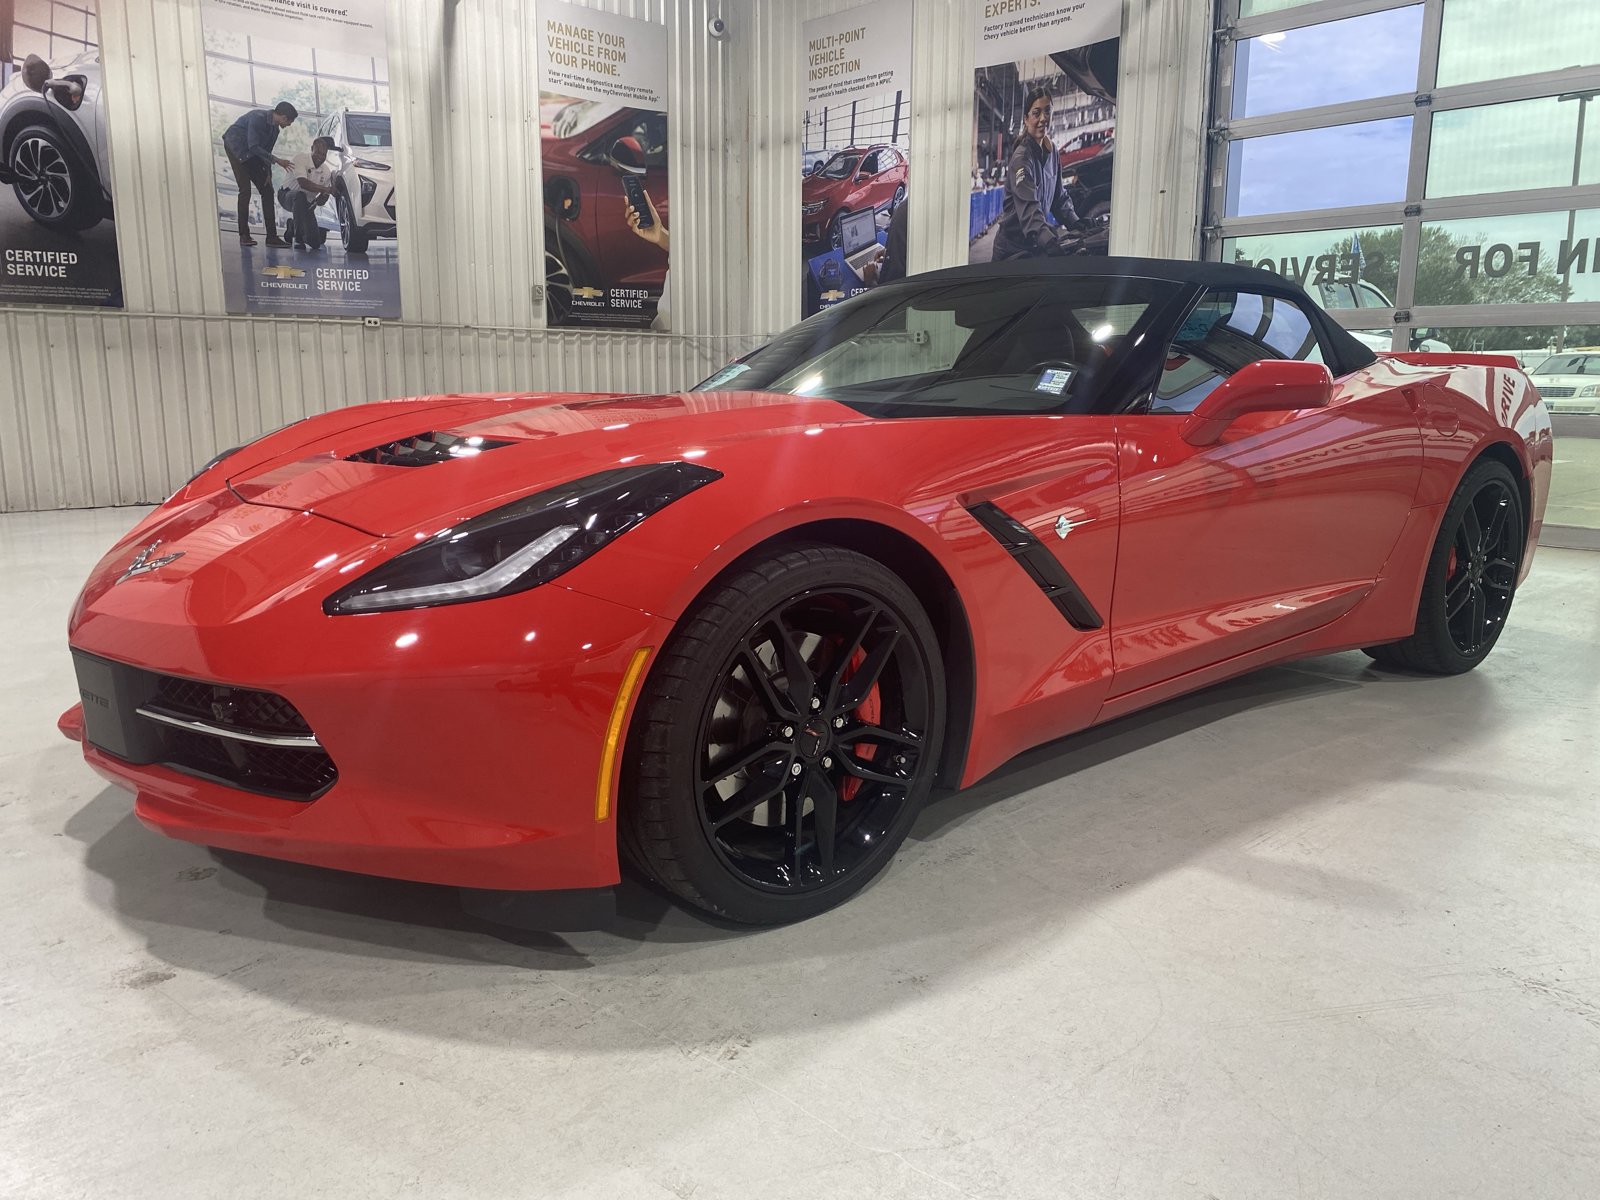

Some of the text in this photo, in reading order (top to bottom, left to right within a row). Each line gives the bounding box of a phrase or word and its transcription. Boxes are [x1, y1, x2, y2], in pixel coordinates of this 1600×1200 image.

[984, 3, 1086, 32] Factory trained technicians know your
[547, 19, 625, 49] MANAGE YOUR
[983, 15, 1073, 41] Chevy vehicle better than anyone.
[547, 35, 627, 63] VEHICLE FROM
[809, 27, 866, 52] MULTI-POINT
[548, 50, 621, 77] YOUR PHONE.
[808, 48, 845, 67] VEHICLE
[809, 58, 861, 82] INSPECTION
[548, 68, 561, 77] View
[561, 72, 585, 83] real-time
[585, 76, 613, 89] diagnostics
[614, 82, 623, 90] and
[623, 84, 636, 93] enjoy
[563, 80, 586, 90] available
[593, 85, 602, 93] the
[602, 88, 632, 98] myChevrolet
[5, 249, 78, 264] CERTIFIED
[7, 263, 67, 278] SERVICE
[316, 267, 369, 280] CERTIFIED
[261, 281, 308, 290] CHEVROLET
[316, 280, 361, 292] SERVICE
[610, 288, 649, 299] CERTIFIED
[610, 299, 642, 309] SERVICE
